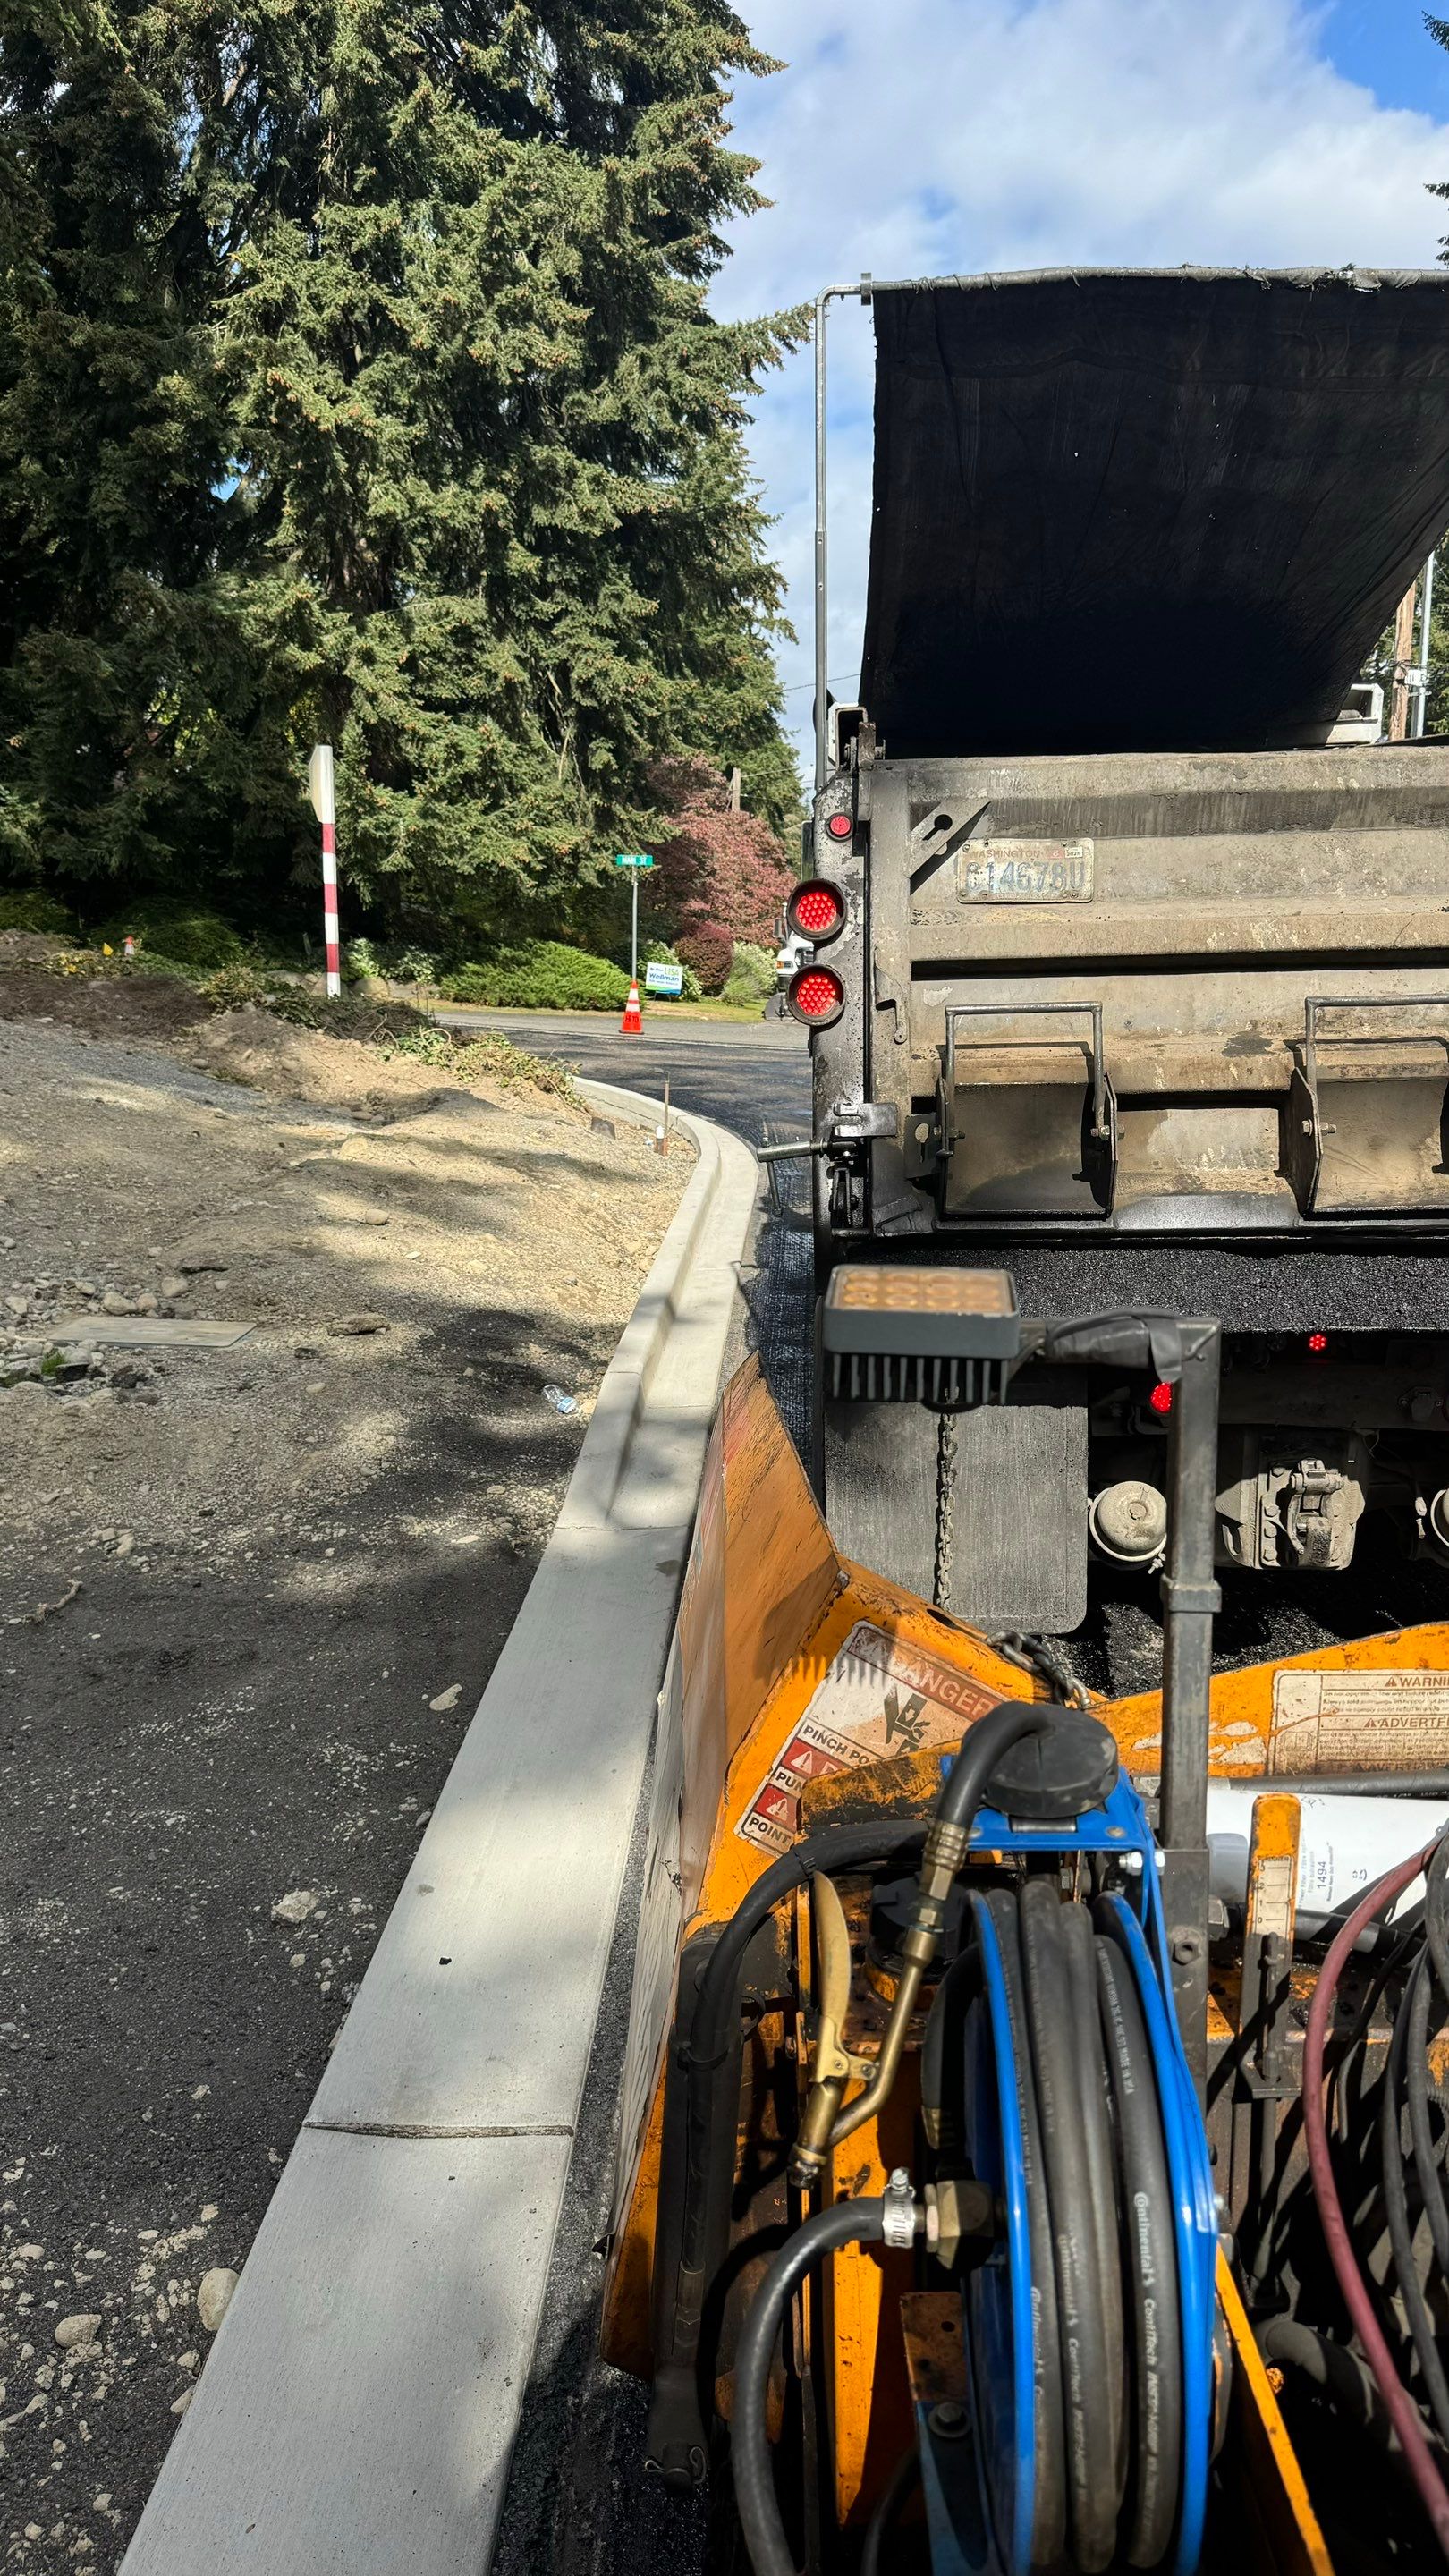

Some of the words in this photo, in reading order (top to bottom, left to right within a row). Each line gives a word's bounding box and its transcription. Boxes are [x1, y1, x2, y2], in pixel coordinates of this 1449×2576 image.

[970, 851, 1040, 859] WASHINGTON
[649, 972, 680, 982] Wellman
[902, 1657, 996, 1716] ANGER
[1400, 1676, 1449, 1687] WARNI
[804, 1723, 847, 1756] PINCH
[748, 1816, 792, 1845] POINT
[1317, 1861, 1327, 1889] 1494
[1133, 2191, 1154, 2274] Continental
[1144, 2297, 1159, 2367] ContiTech
